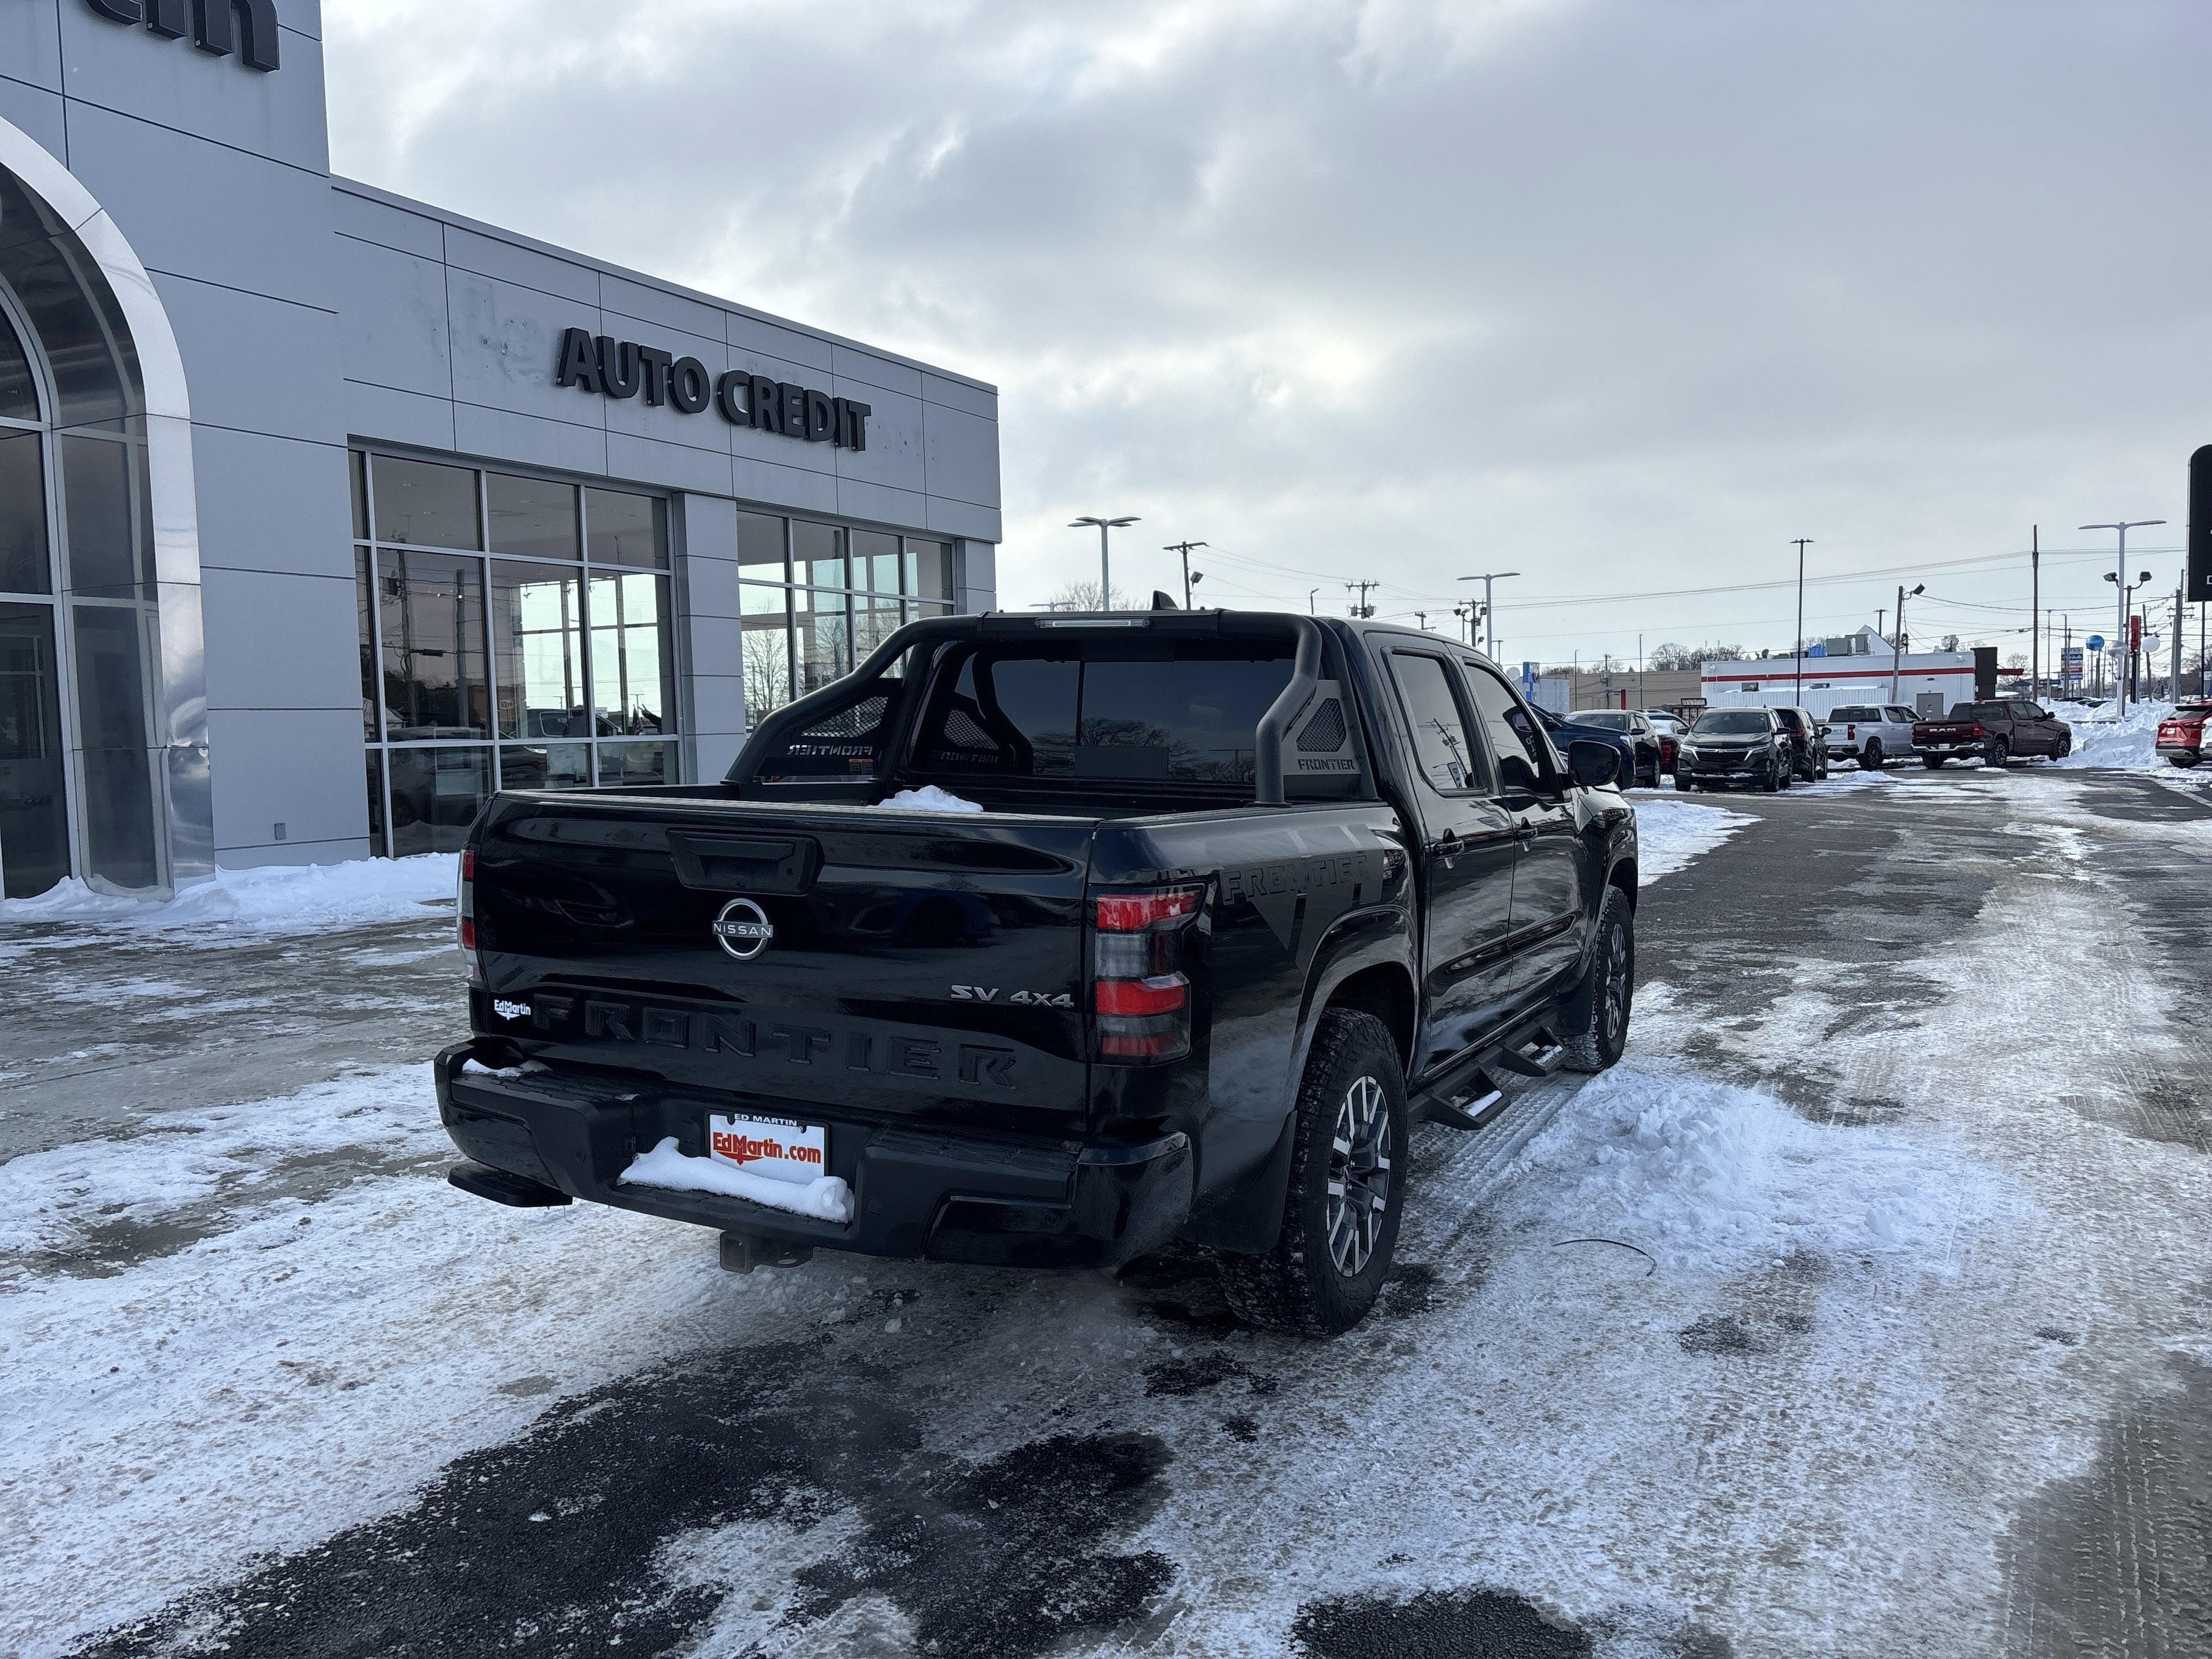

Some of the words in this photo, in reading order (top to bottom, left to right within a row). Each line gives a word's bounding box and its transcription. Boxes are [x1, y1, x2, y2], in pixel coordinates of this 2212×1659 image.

[556, 327, 710, 414] AUTO
[717, 369, 872, 452] CREDIT
[1297, 758, 1356, 770] FRONTIER
[1220, 854, 1368, 904] FRONTIER
[714, 923, 771, 936] NISSAN
[950, 985, 1000, 1002] SV
[494, 999, 531, 1015] EdMartin
[533, 994, 1019, 1091] FRONTIER
[752, 1116, 797, 1126] MARTIN
[713, 1132, 821, 1164] EdMartin.com
